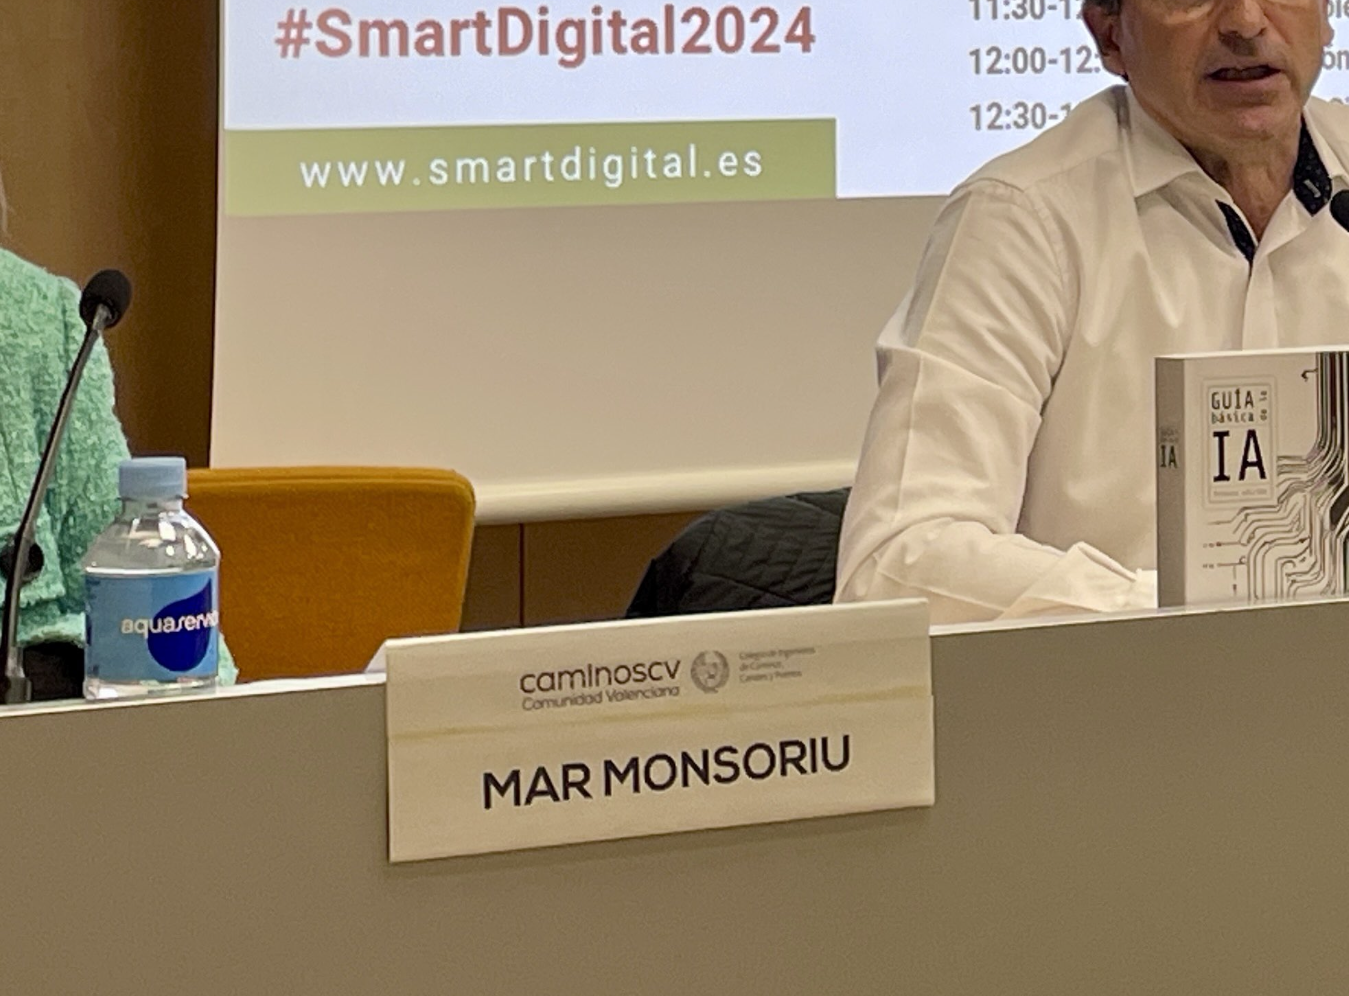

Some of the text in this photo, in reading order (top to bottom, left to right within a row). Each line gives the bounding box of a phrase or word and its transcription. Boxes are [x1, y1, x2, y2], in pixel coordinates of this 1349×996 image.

[274, 4, 816, 68] #SmartDigital2024
[300, 144, 761, 188] www.smartdigital.es
[1211, 387, 1255, 410] GUÍA
[1159, 445, 1178, 468] IA
[1212, 429, 1267, 483] IA
[519, 659, 682, 694] caminoscv
[522, 685, 681, 711] Comunidad Valenciana
[483, 735, 849, 810] MAR MONSORIU
